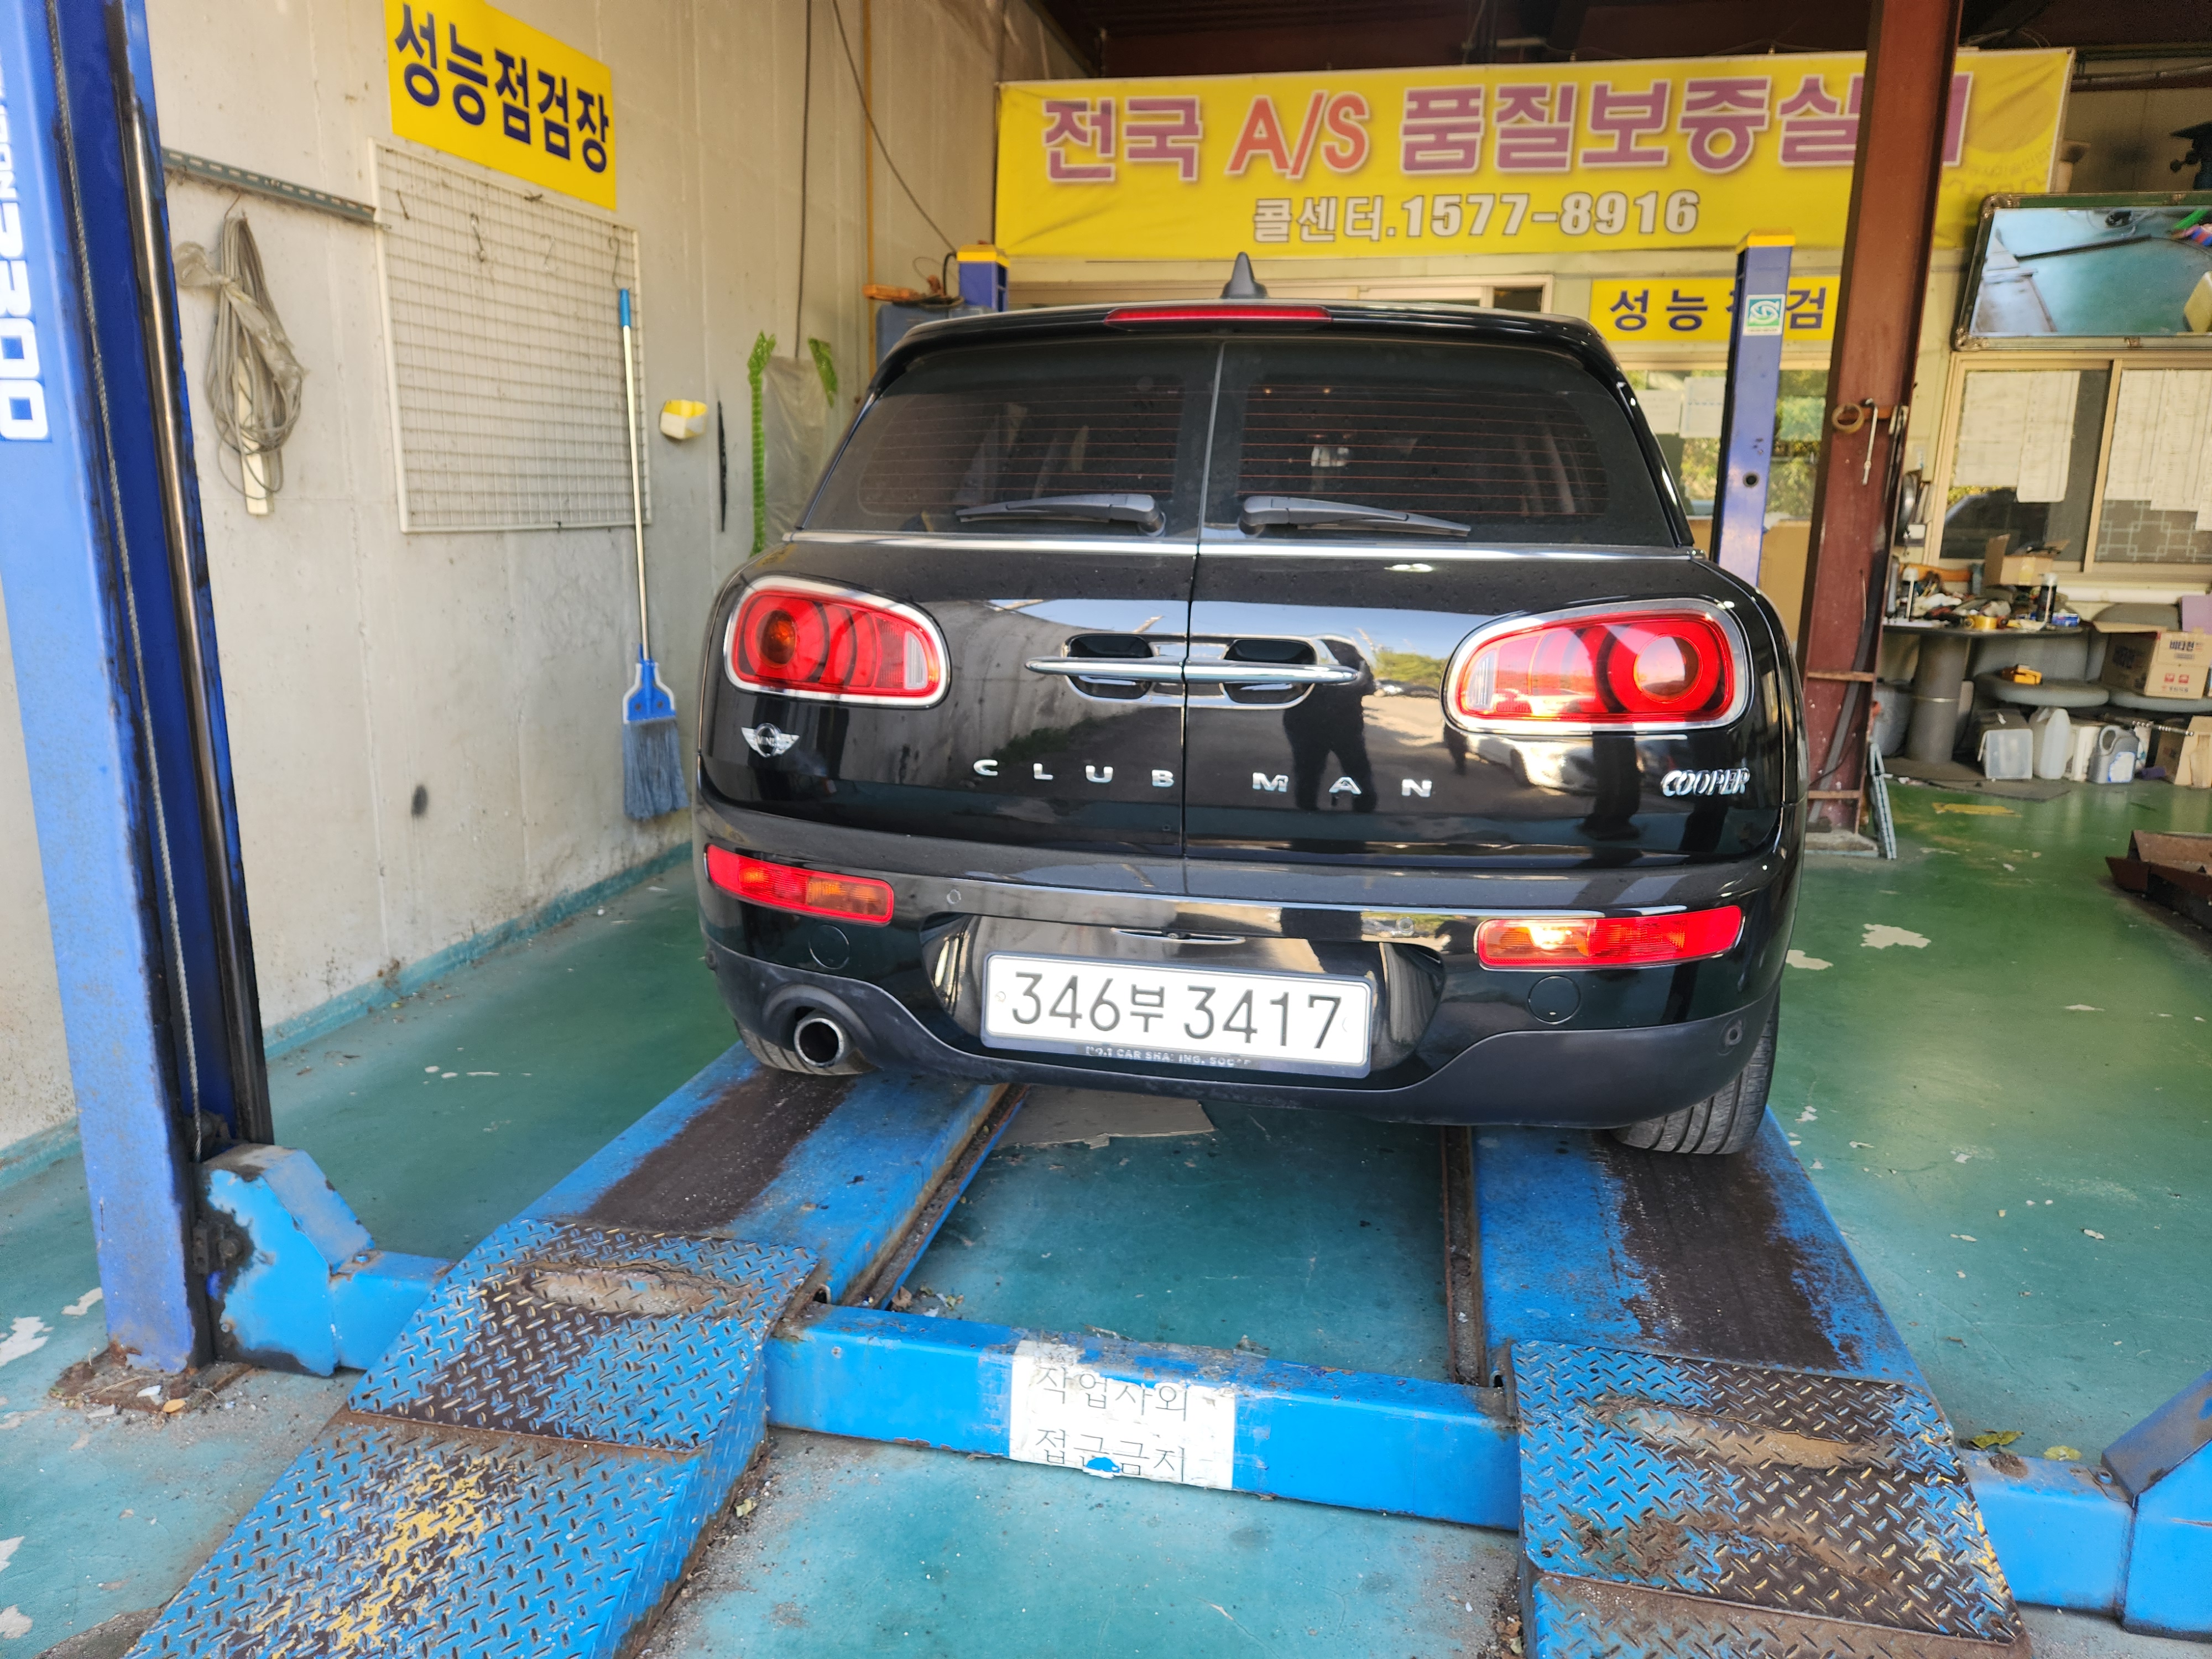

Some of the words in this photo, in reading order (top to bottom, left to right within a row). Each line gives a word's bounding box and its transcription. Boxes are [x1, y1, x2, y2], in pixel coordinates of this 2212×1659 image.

[394, 2, 609, 174] 성능점검장
[1042, 97, 1203, 182] 전국
[1224, 90, 1371, 180] A/S
[1400, 72, 1974, 175] 품질보증실
[1610, 287, 1826, 332] 성능검
[1660, 768, 1751, 797] COOPER
[1011, 972, 1165, 1034] 346부
[1183, 984, 1343, 1050] 3417
[1116, 1048, 1142, 1060] CAR
